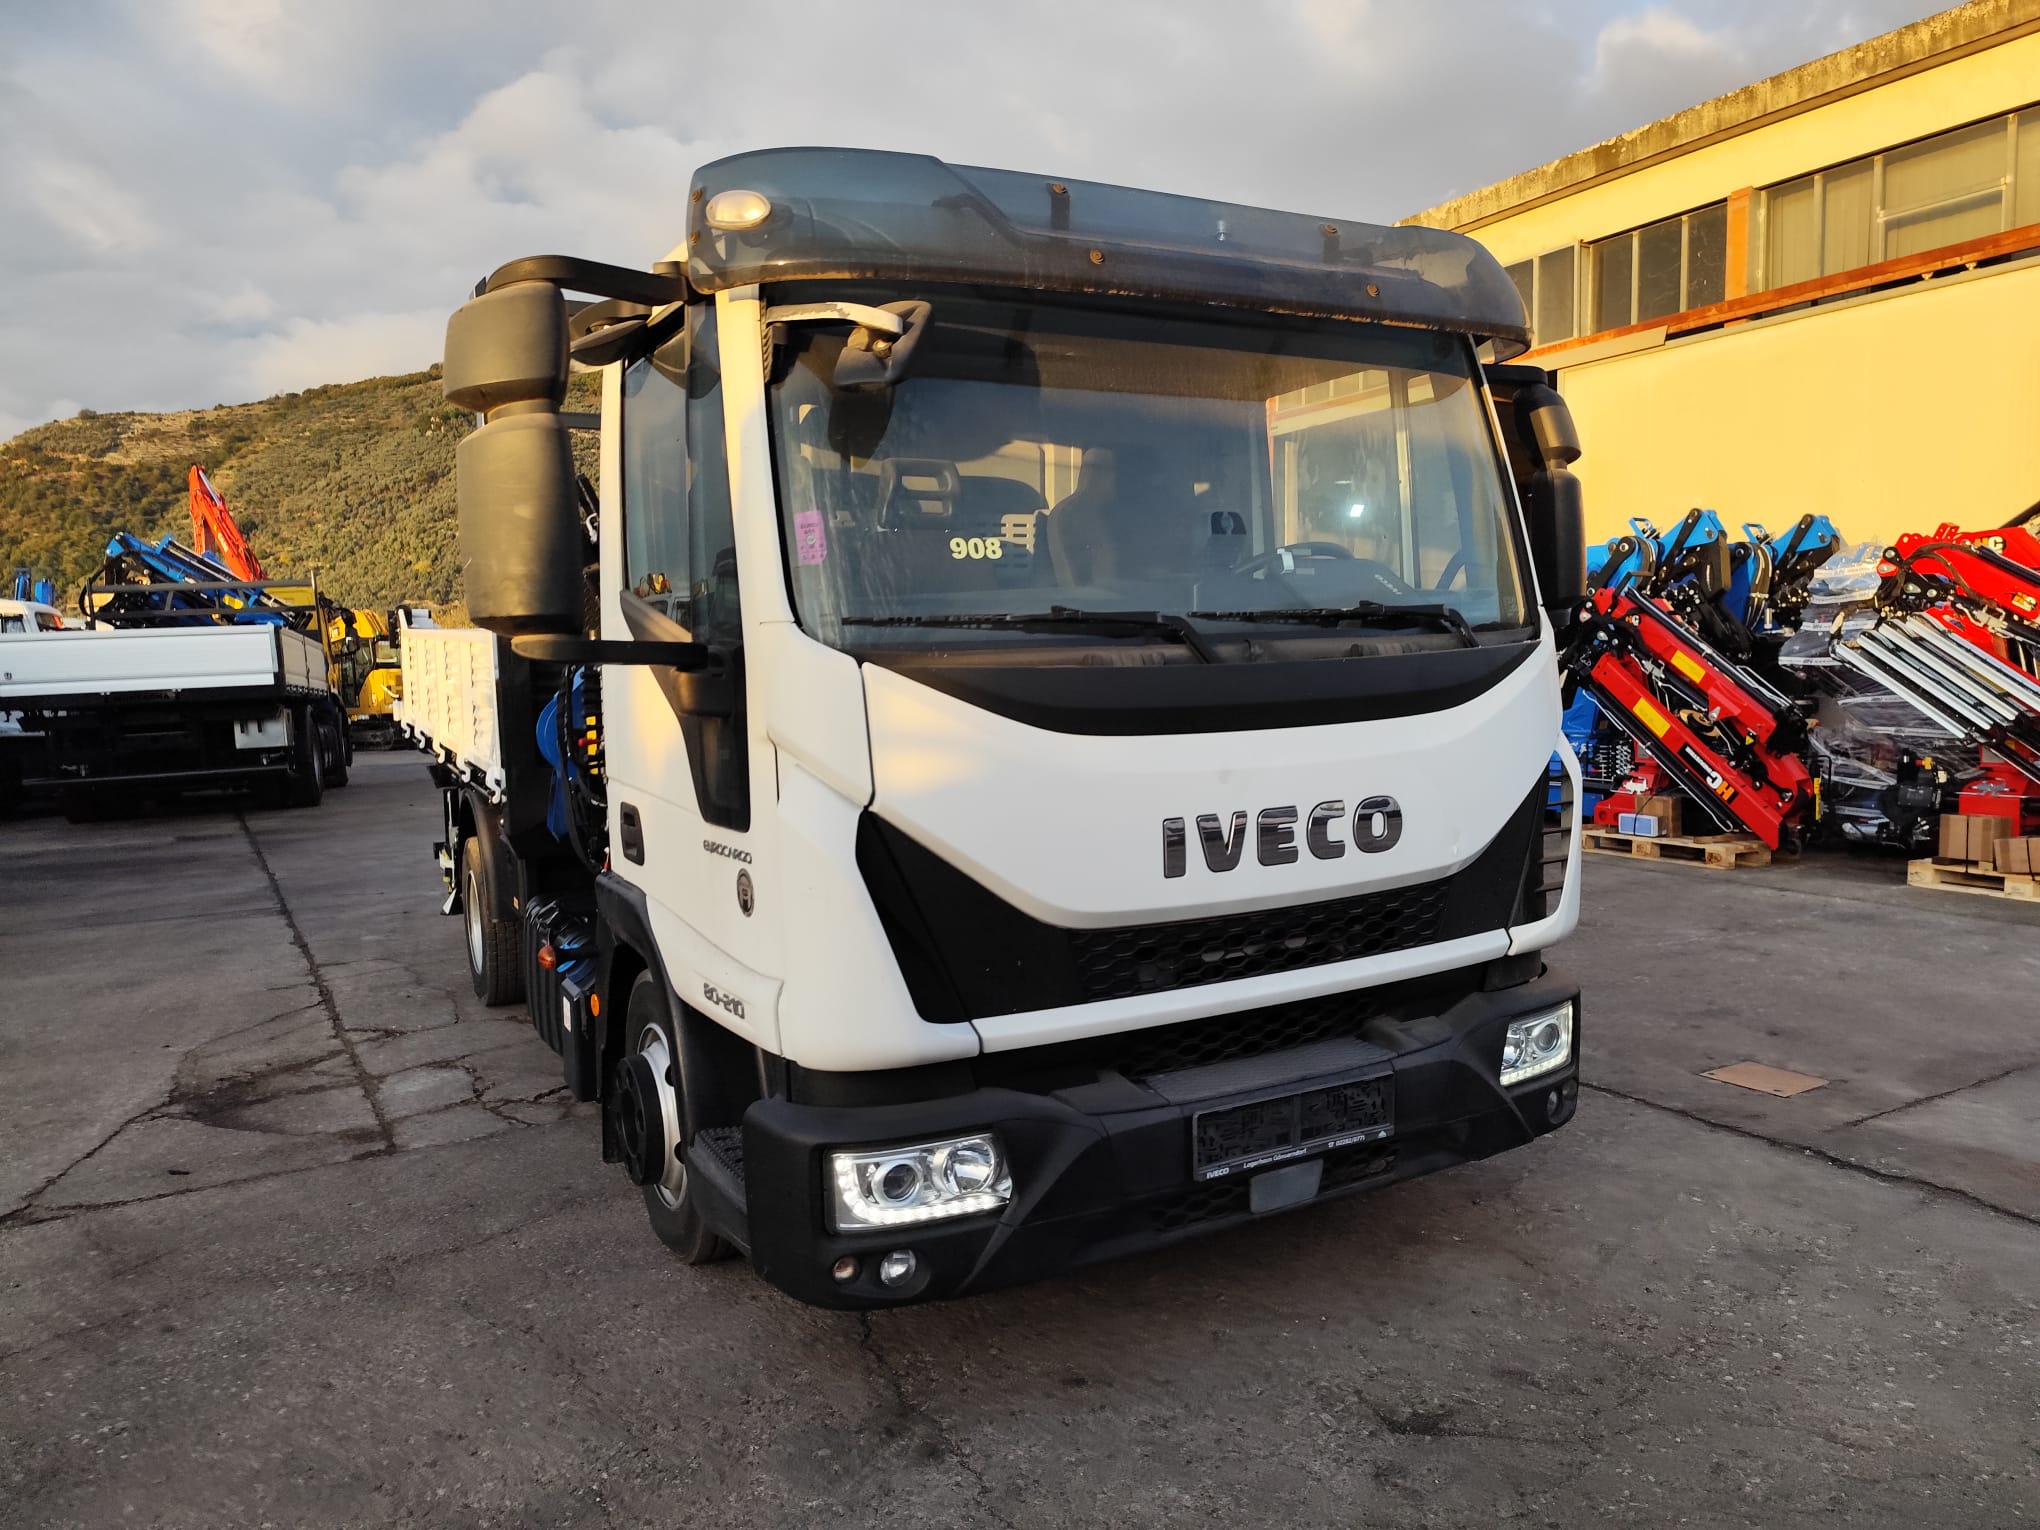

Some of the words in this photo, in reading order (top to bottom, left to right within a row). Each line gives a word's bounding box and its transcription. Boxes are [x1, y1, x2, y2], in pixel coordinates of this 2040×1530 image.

[949, 537, 1003, 560] 908
[1706, 771, 1735, 801] HC
[1162, 795, 1403, 879] IVECO
[1206, 1167, 1230, 1179] IVECO
